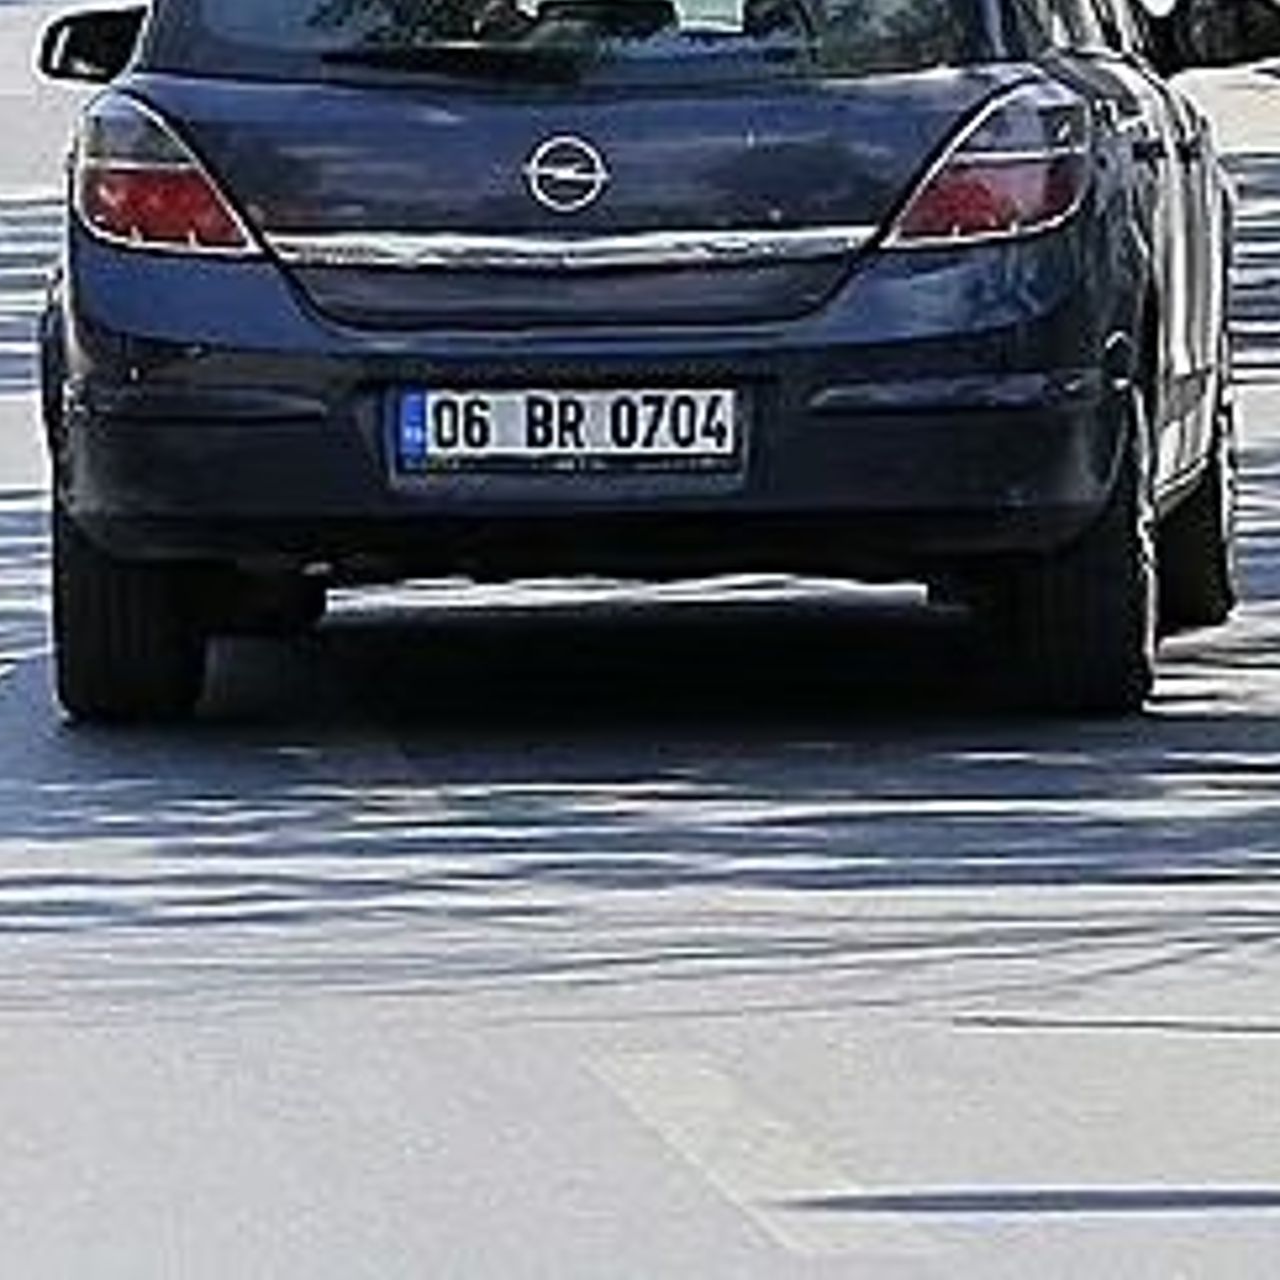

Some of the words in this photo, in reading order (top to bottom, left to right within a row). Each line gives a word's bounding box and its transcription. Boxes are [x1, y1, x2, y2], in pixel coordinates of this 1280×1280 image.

[433, 398, 492, 449] 06
[525, 394, 586, 449] BR
[611, 394, 727, 449] 0704
